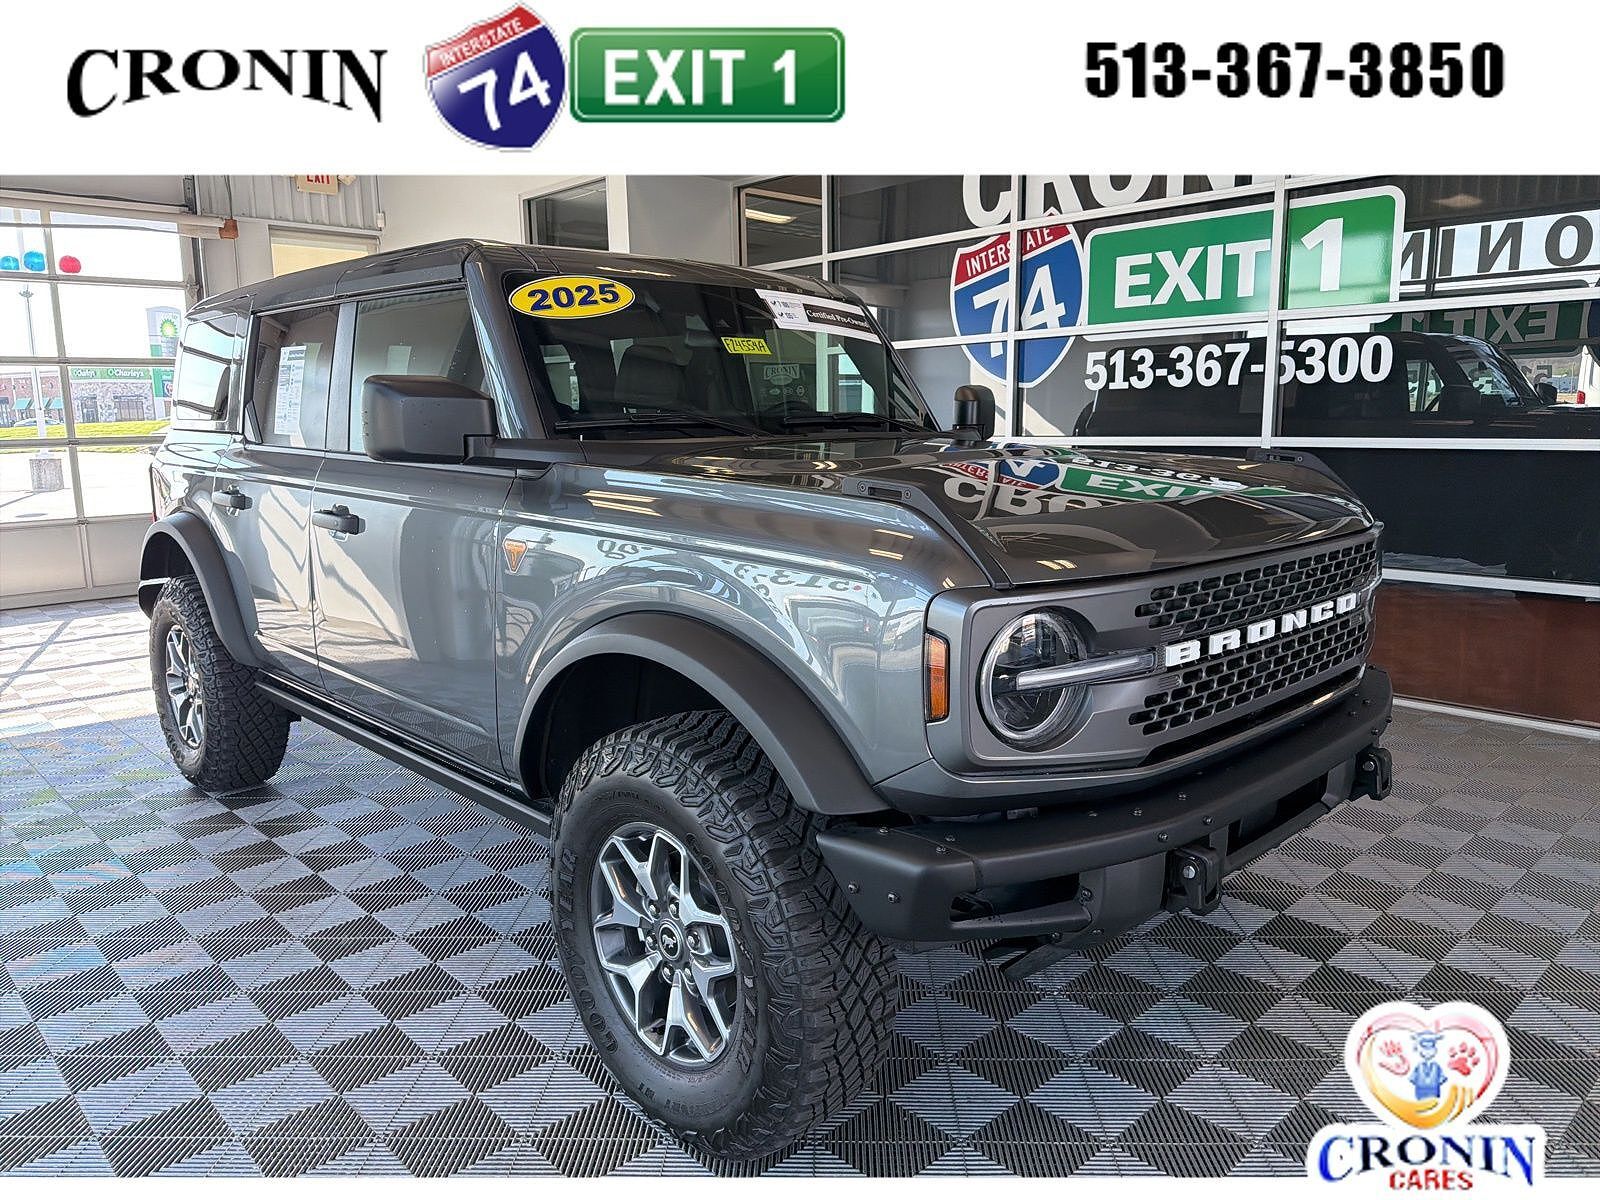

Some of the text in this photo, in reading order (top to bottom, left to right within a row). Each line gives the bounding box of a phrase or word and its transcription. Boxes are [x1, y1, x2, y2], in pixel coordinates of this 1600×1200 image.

[527, 283, 620, 311] 2025
[1114, 217, 1344, 308] EXIT 1
[972, 264, 1066, 358] 74
[1165, 592, 1356, 667] BRONCO
